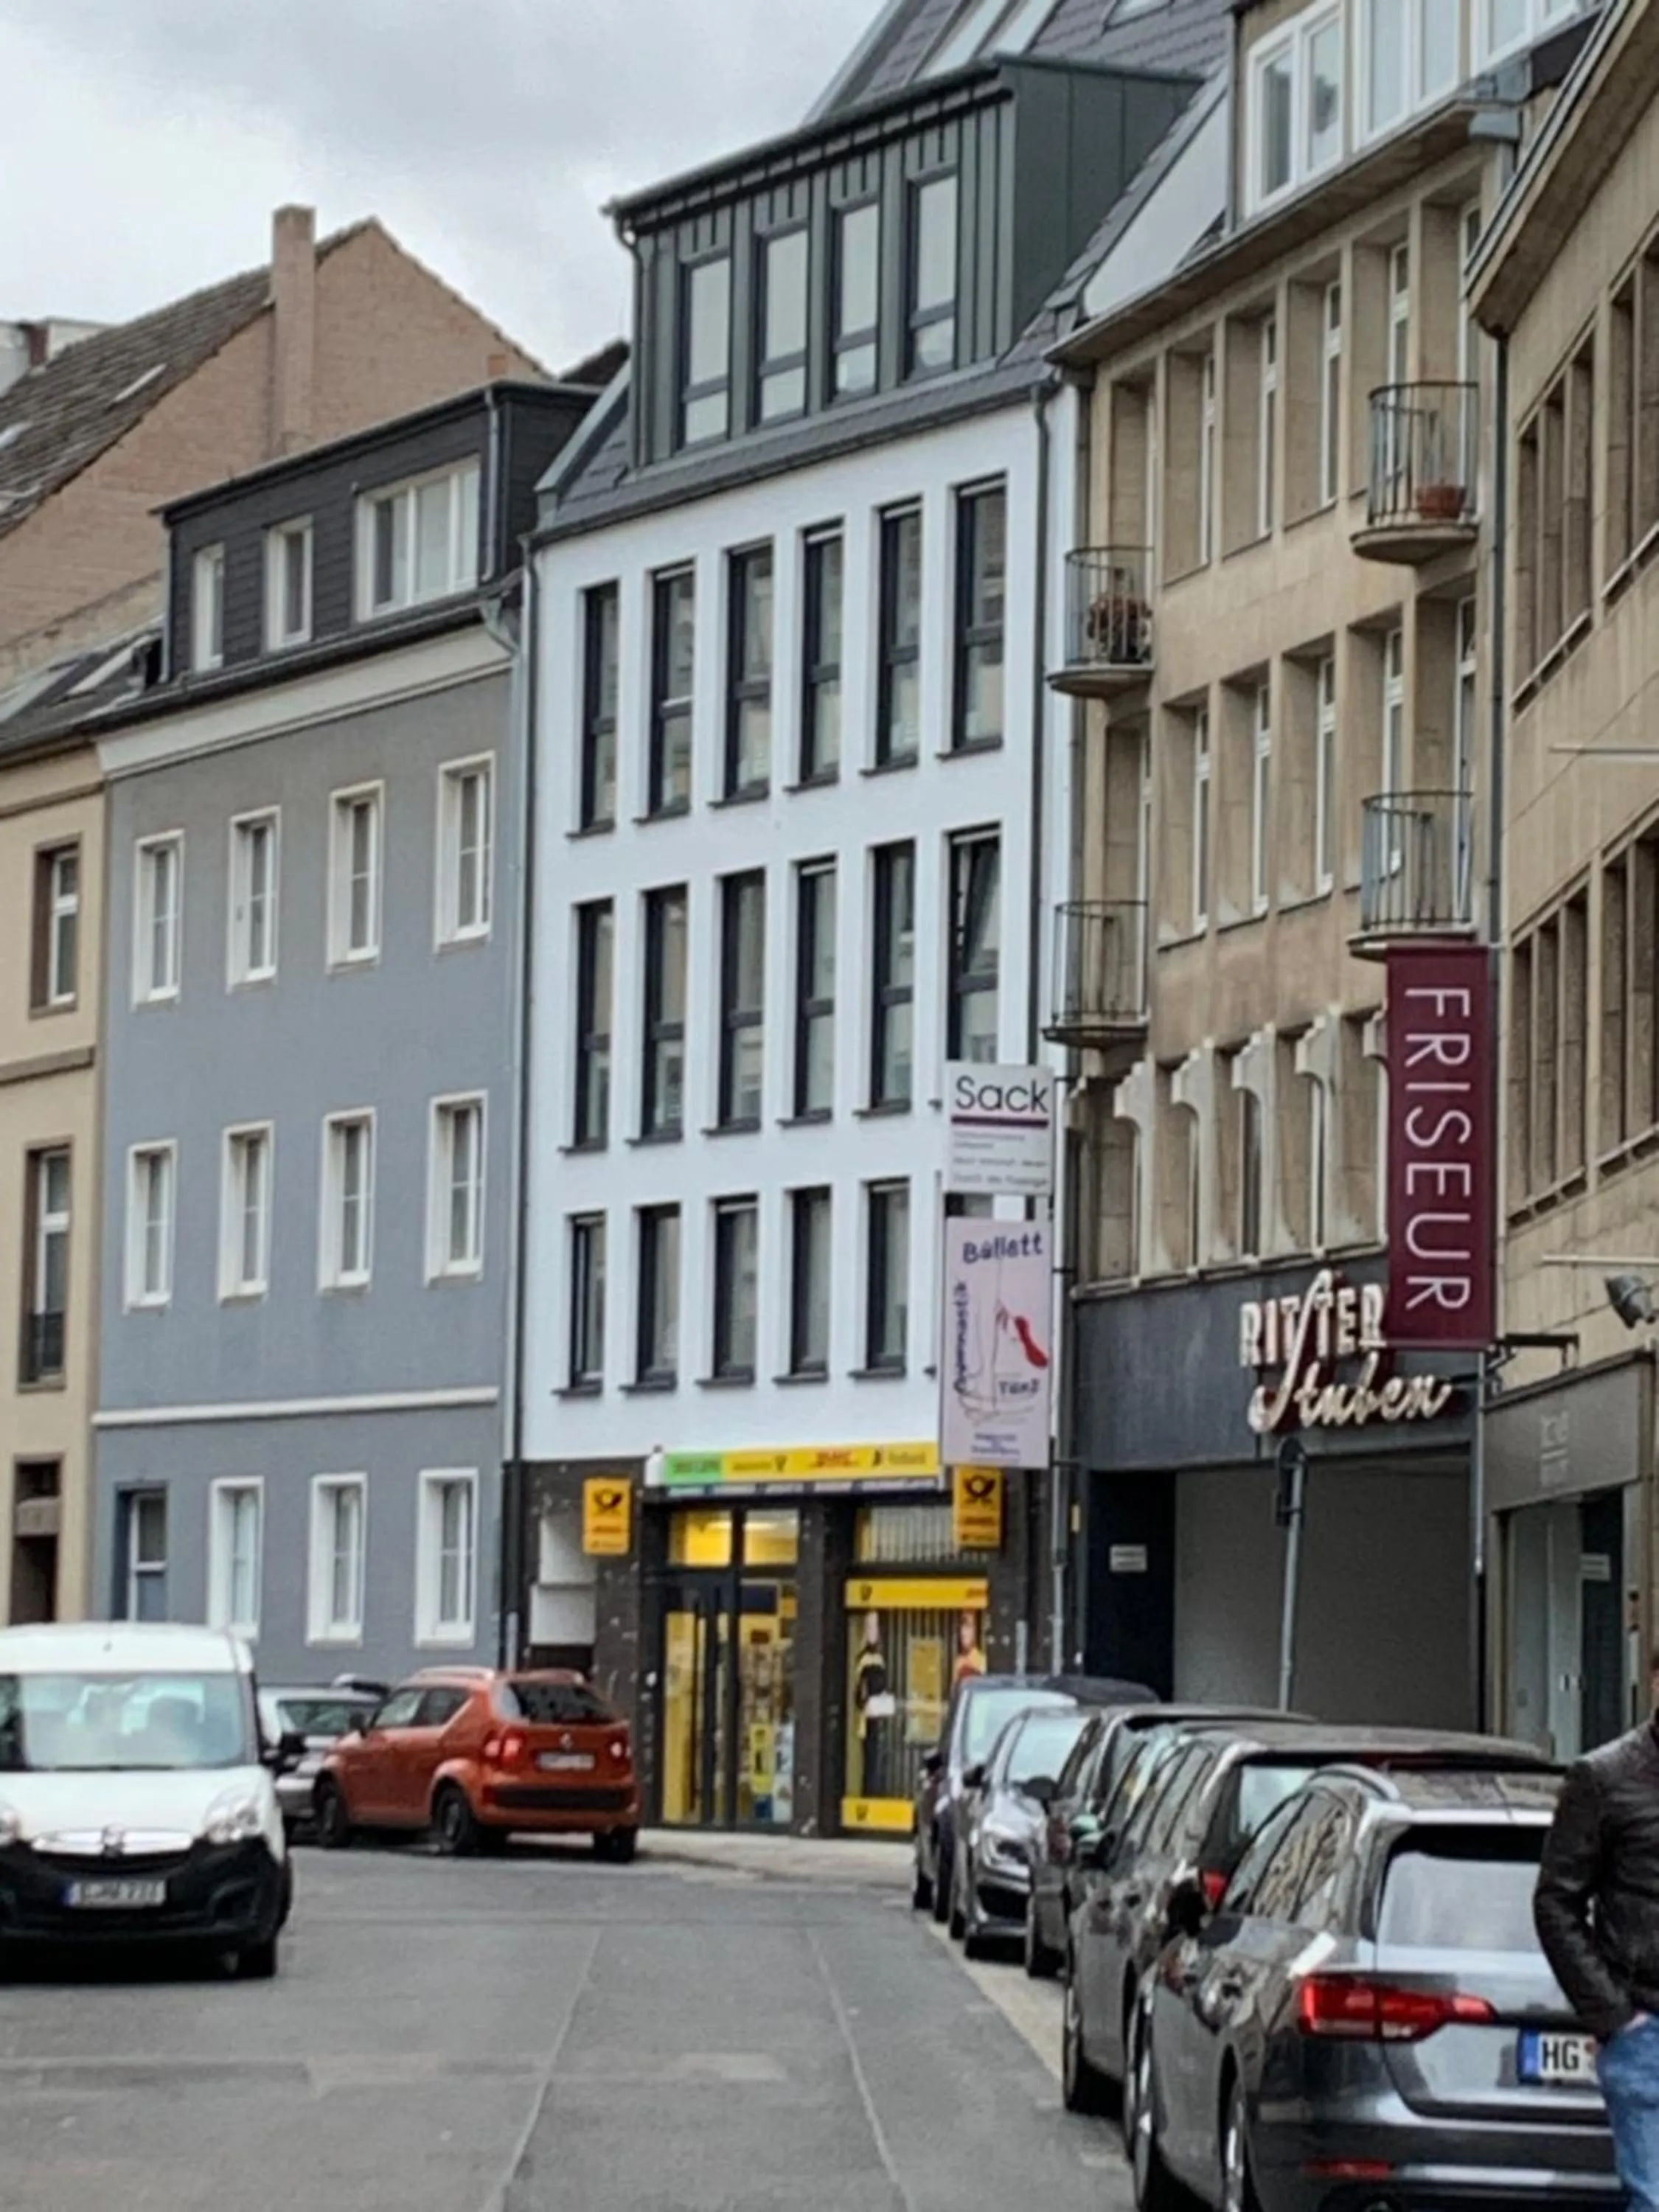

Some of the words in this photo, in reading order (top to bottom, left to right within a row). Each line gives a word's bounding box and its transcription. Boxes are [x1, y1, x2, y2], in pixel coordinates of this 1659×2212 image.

[955, 1074, 1048, 1113] Sack
[1405, 988, 1472, 1310] FRISEUR
[962, 1232, 1043, 1264] Ballett
[1240, 1283, 1387, 1367] RITTER
[1248, 1269, 1453, 1432] Stuben
[1542, 2039, 1579, 2070] HG
